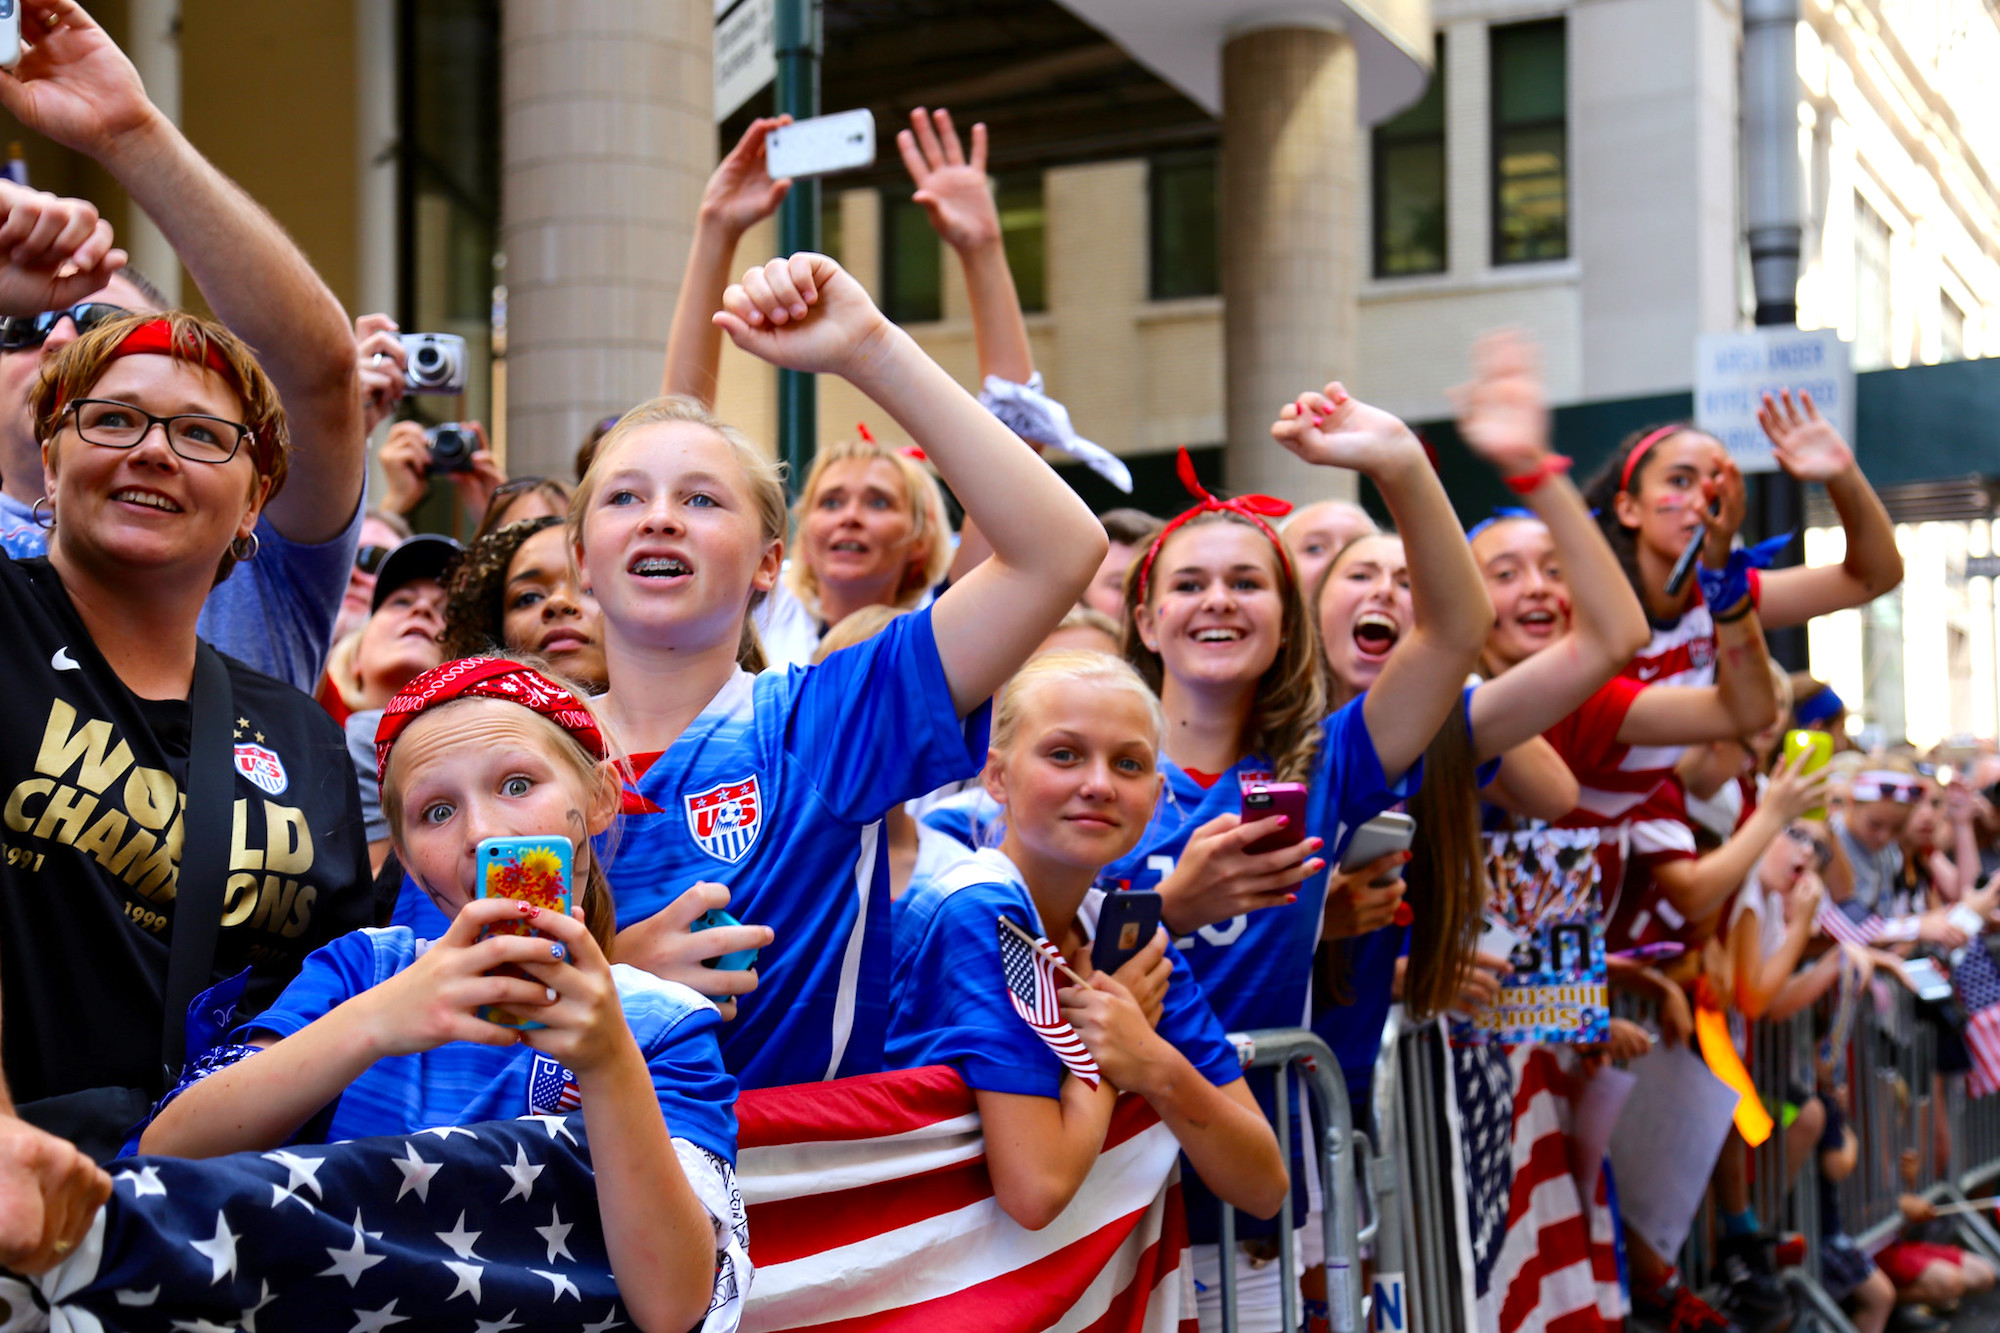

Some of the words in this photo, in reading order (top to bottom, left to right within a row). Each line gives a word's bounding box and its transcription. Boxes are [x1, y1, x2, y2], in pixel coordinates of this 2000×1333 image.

[34, 697, 315, 876] WOLD
[697, 797, 757, 837] US
[3, 777, 318, 939] CHAMONS
[123, 901, 168, 933] 1999
[543, 1063, 574, 1082] US
[1374, 1282, 1404, 1331] N
